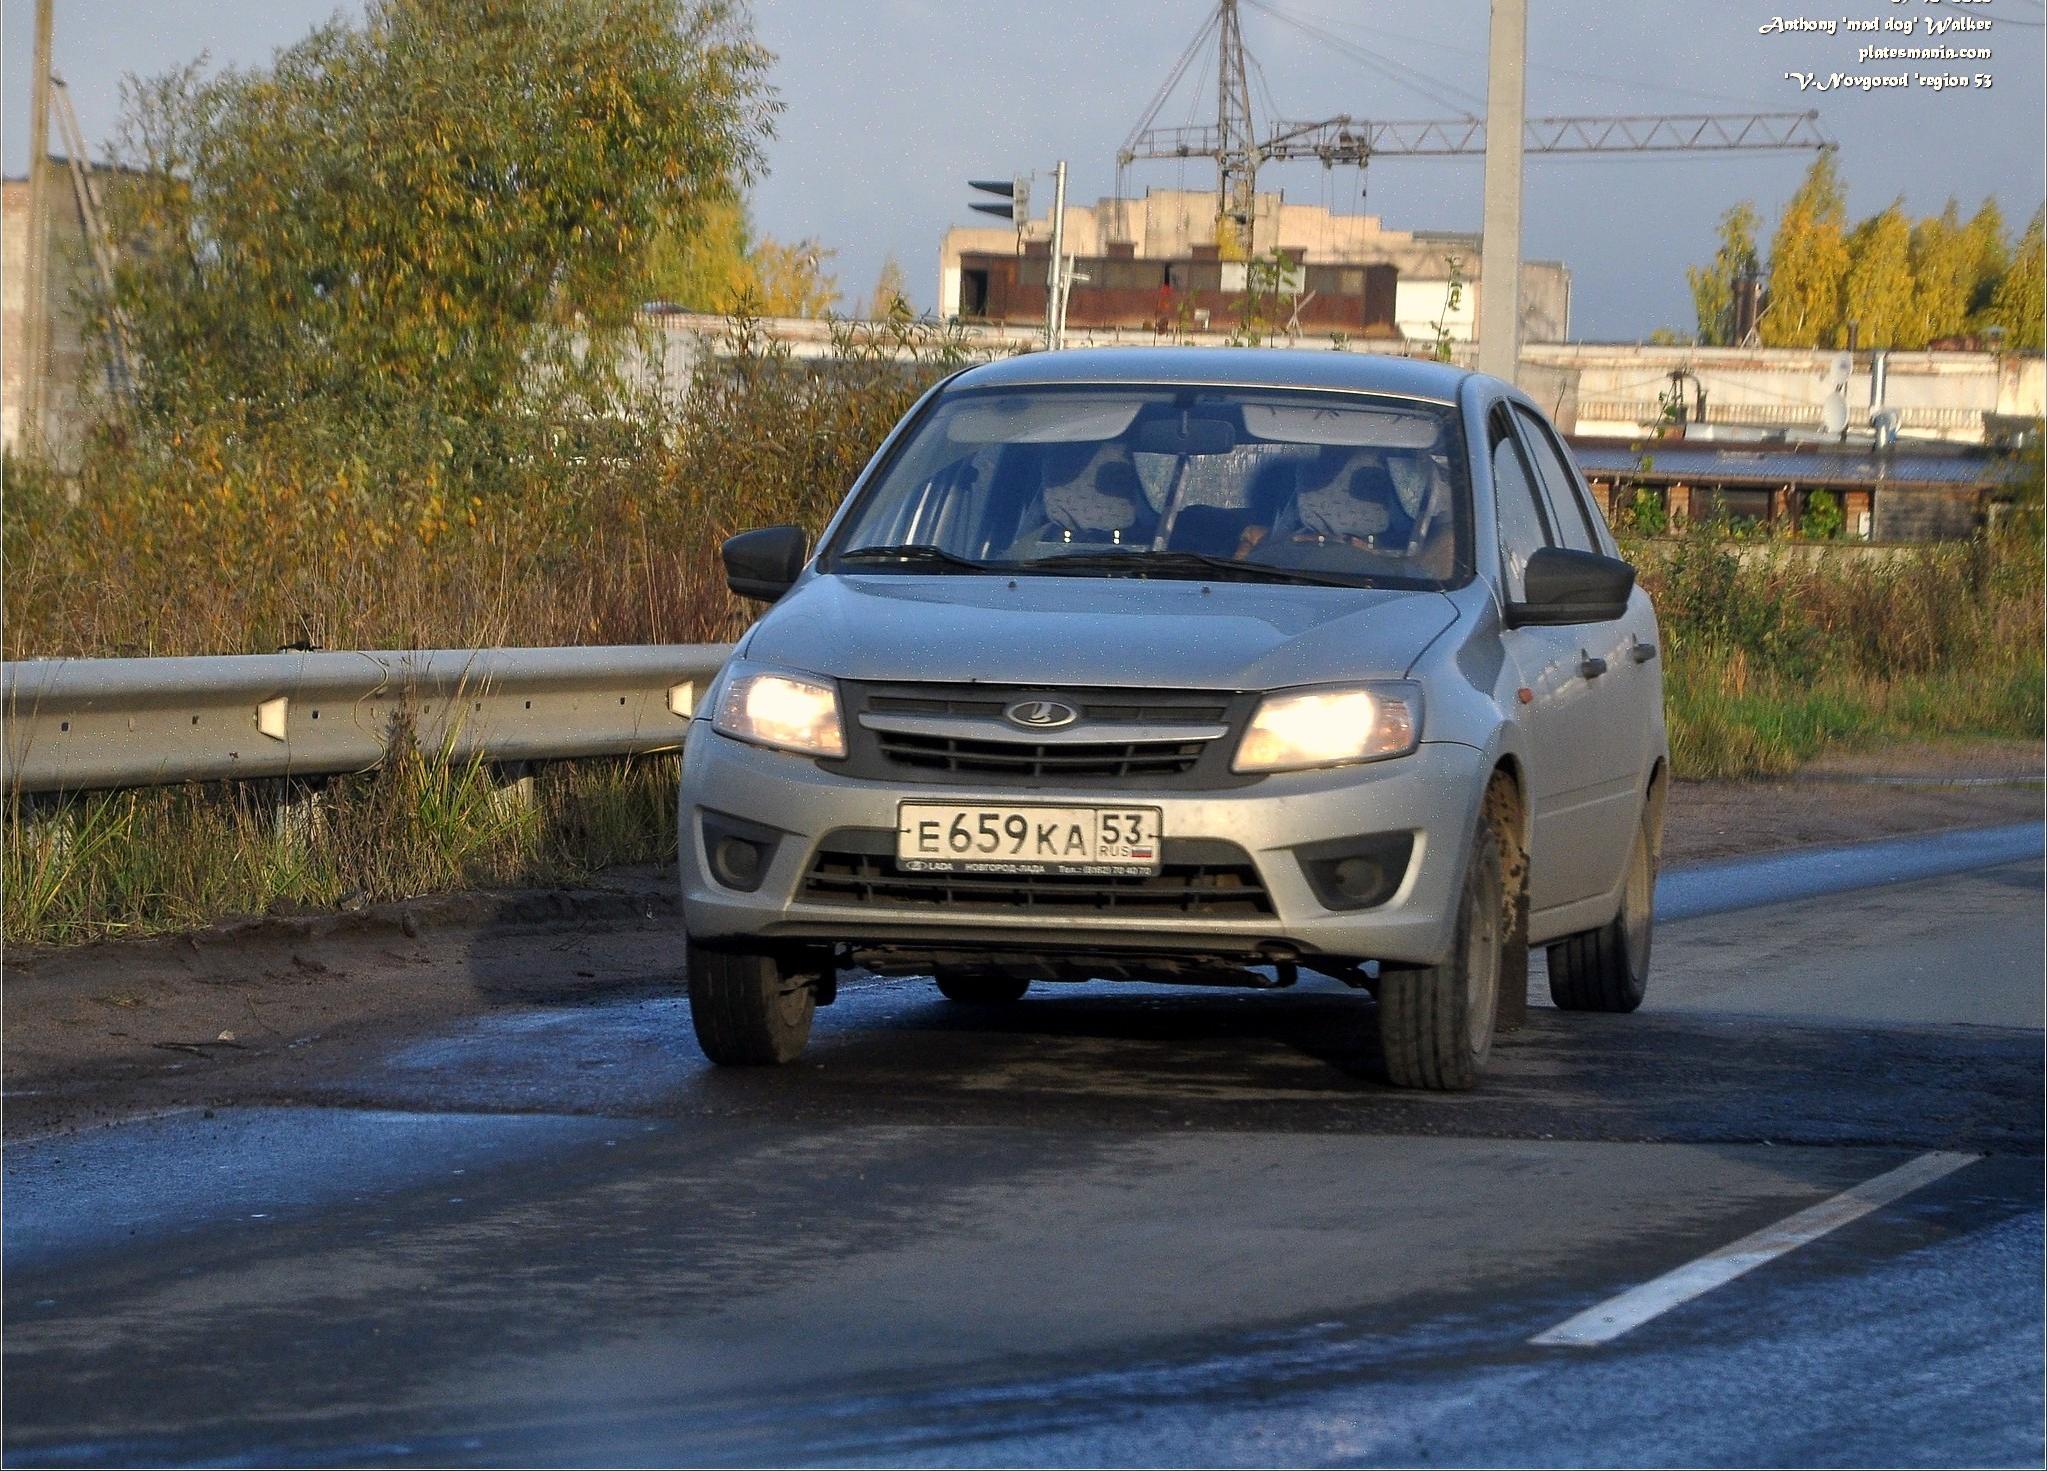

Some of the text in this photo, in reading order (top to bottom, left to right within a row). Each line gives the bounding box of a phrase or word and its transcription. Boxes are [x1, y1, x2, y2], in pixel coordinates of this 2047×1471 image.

[918, 812, 1143, 856] E659KA 53
[1098, 846, 1129, 858] RUS
[928, 862, 954, 871] LADA
